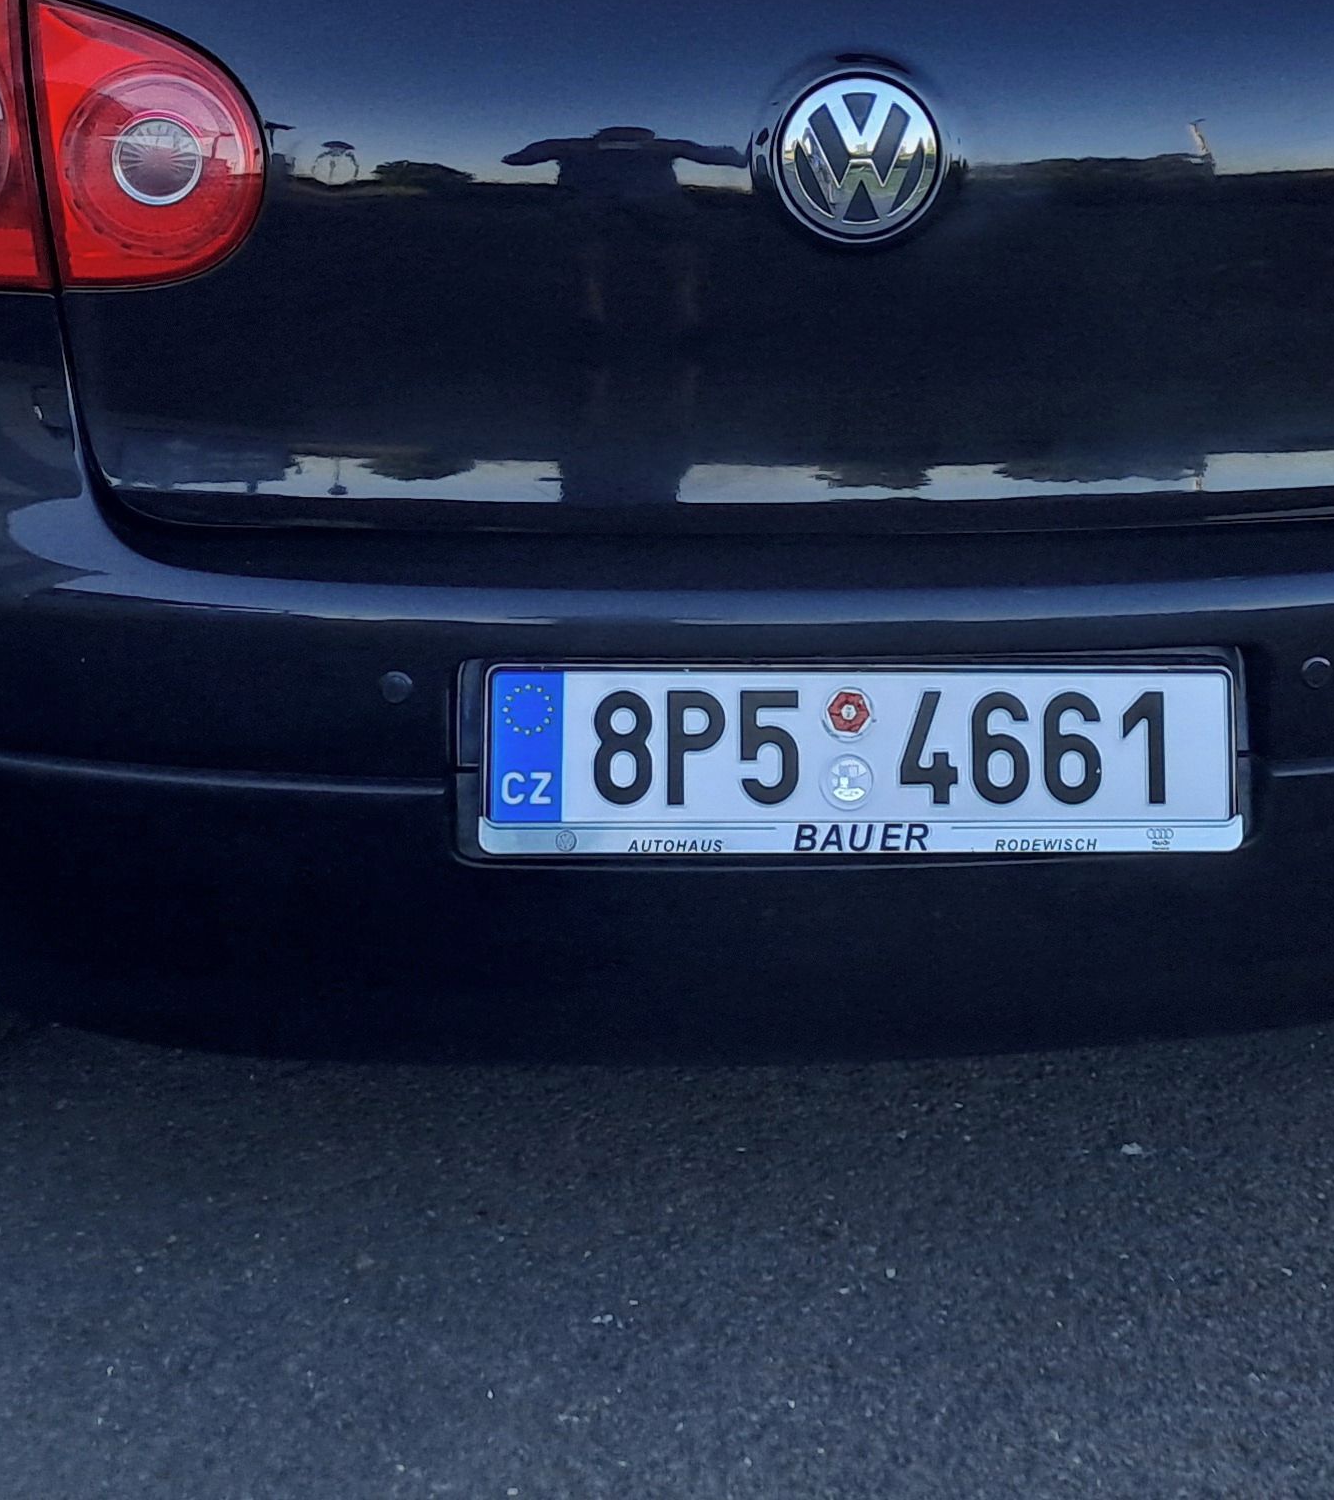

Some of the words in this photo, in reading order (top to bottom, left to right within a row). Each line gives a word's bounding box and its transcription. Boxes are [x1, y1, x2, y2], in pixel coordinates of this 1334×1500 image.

[593, 690, 799, 805] 8P5
[900, 691, 1166, 804] 4661
[501, 771, 553, 805] CZ
[627, 839, 724, 852] AUTOHAUS
[793, 823, 930, 852] BAUER
[995, 838, 1098, 851] RODEWISCH
